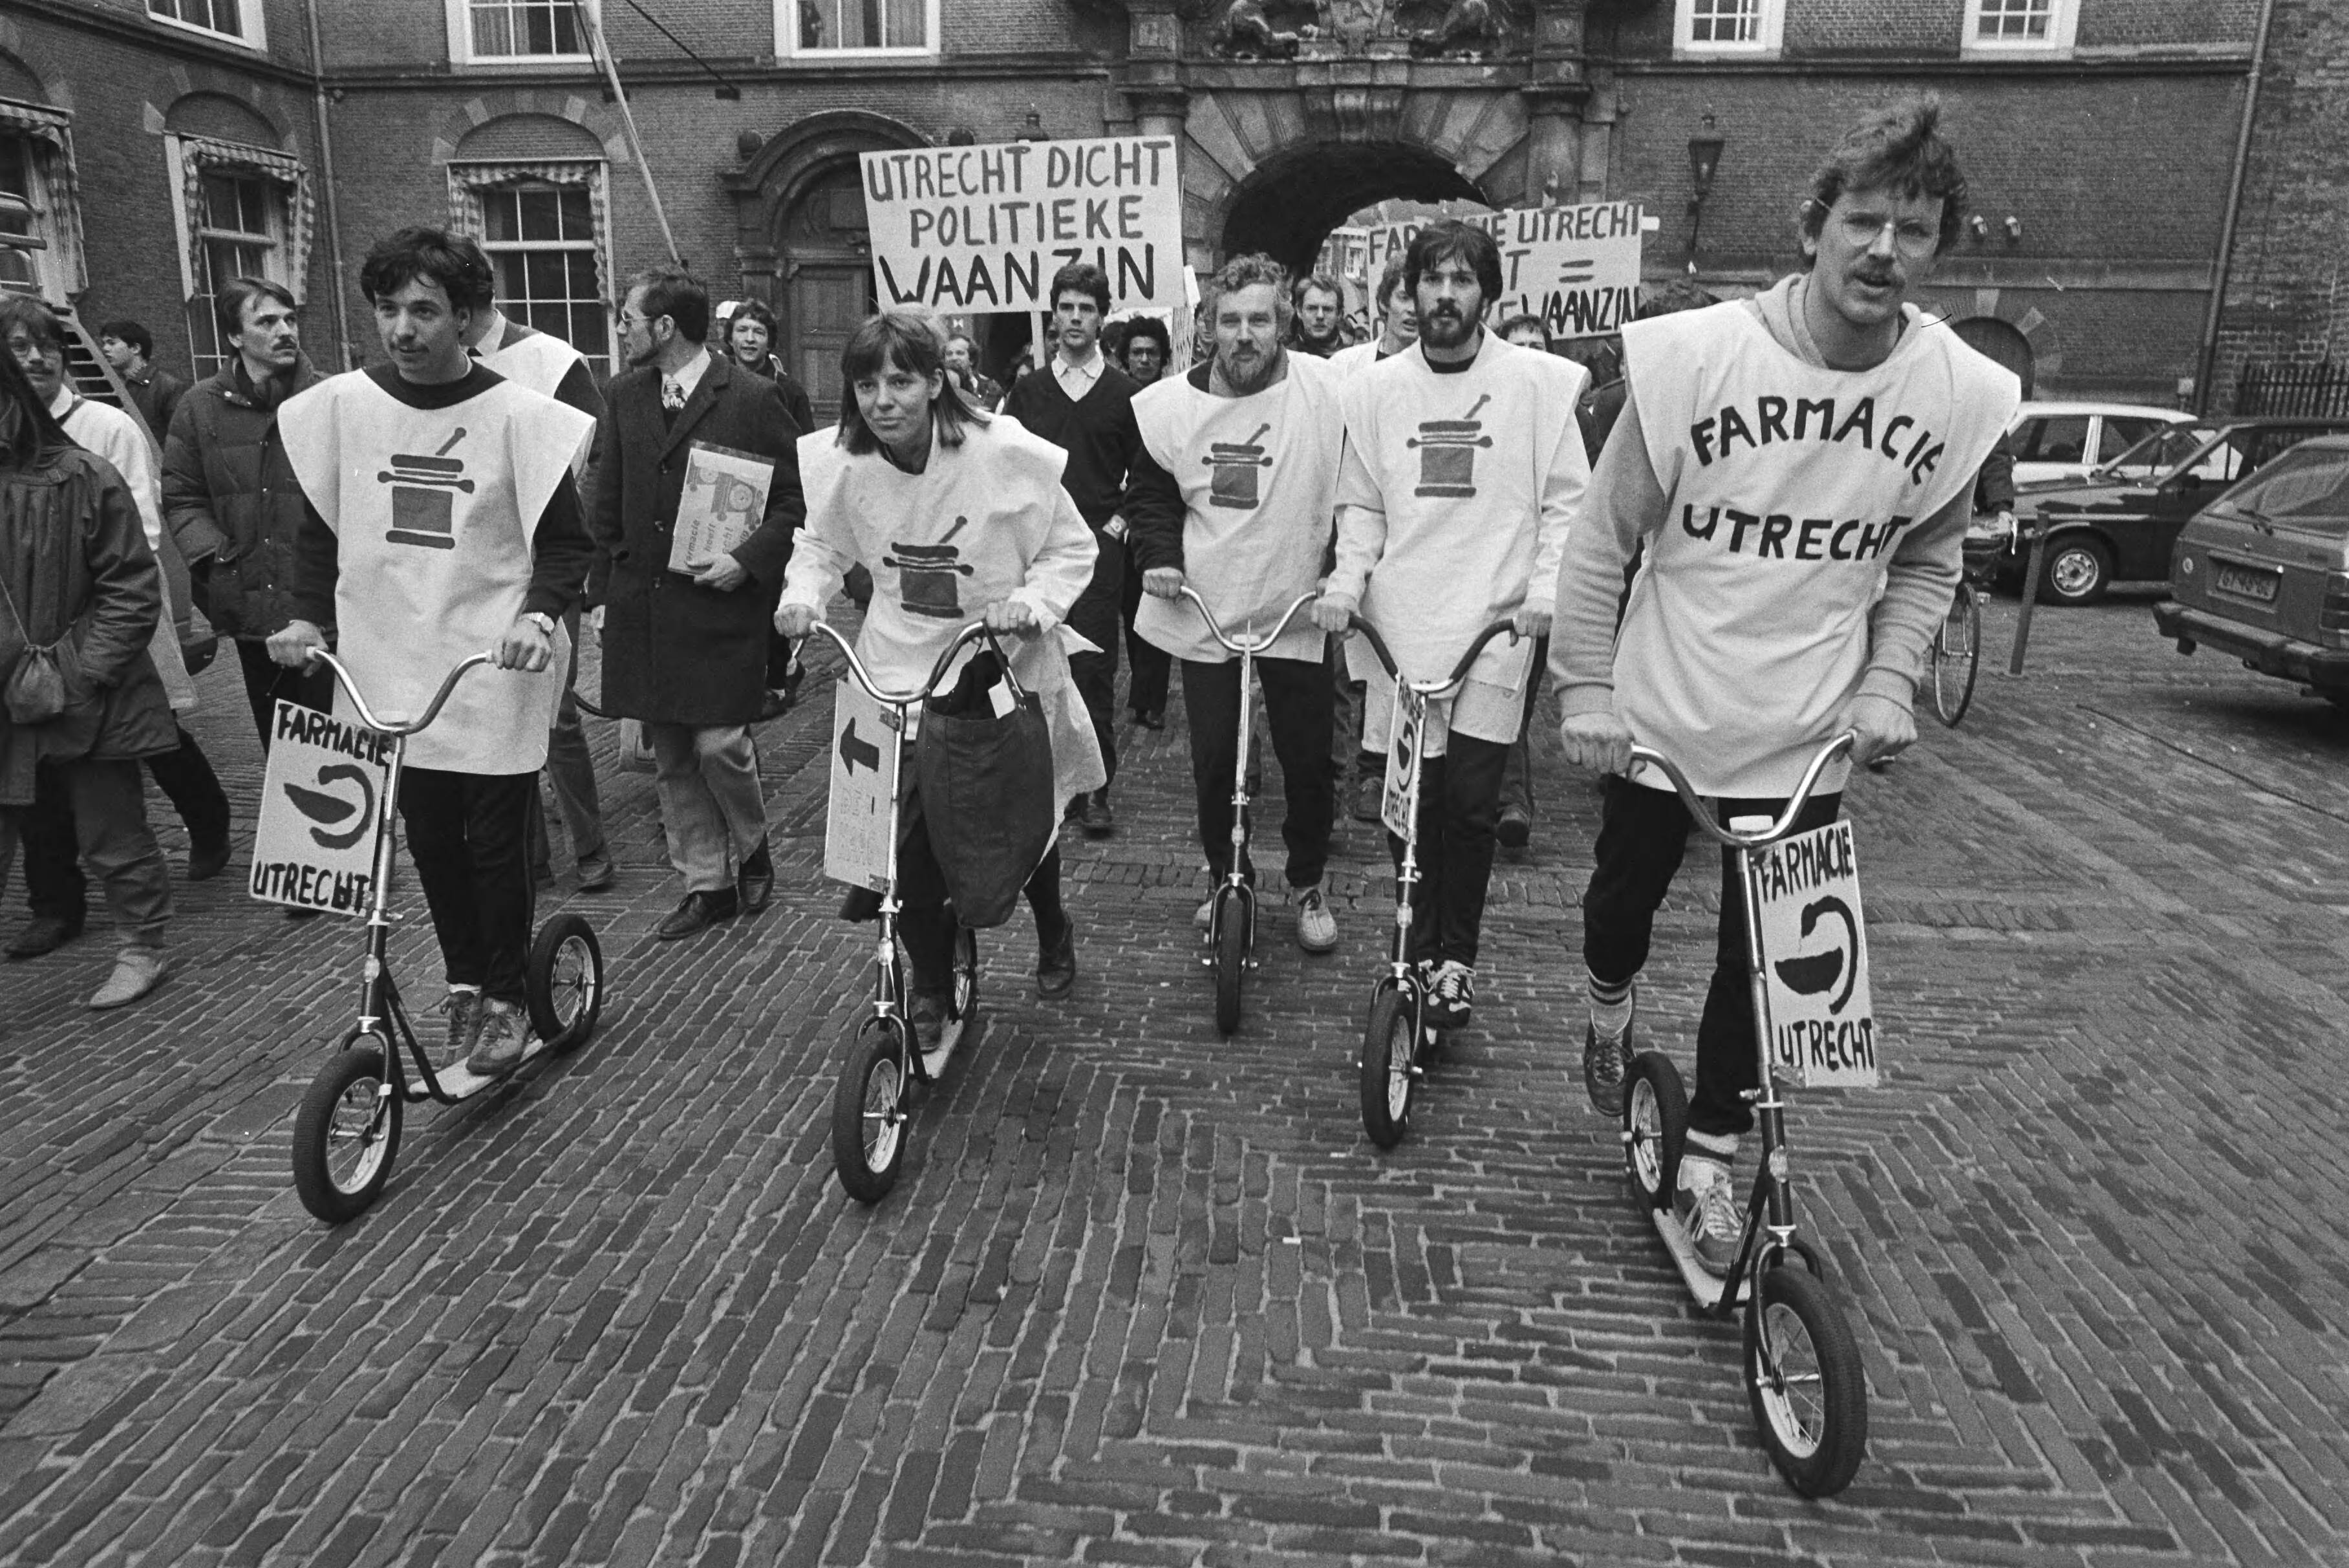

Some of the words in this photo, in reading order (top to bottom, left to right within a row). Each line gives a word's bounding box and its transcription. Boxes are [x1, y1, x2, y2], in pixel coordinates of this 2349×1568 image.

[868, 145, 1031, 201] UTRECHT
[1047, 141, 1171, 188] DICHT
[910, 195, 1143, 248] POLITIEKE
[1690, 396, 1945, 486] FARMACIE
[1682, 503, 1912, 561] UTRECHT
[277, 703, 391, 768] FARMACIE
[253, 860, 370, 914] UTRECHT
[1754, 826, 1854, 903] FARMACIE
[1779, 1017, 1874, 1071] UTRECHT
